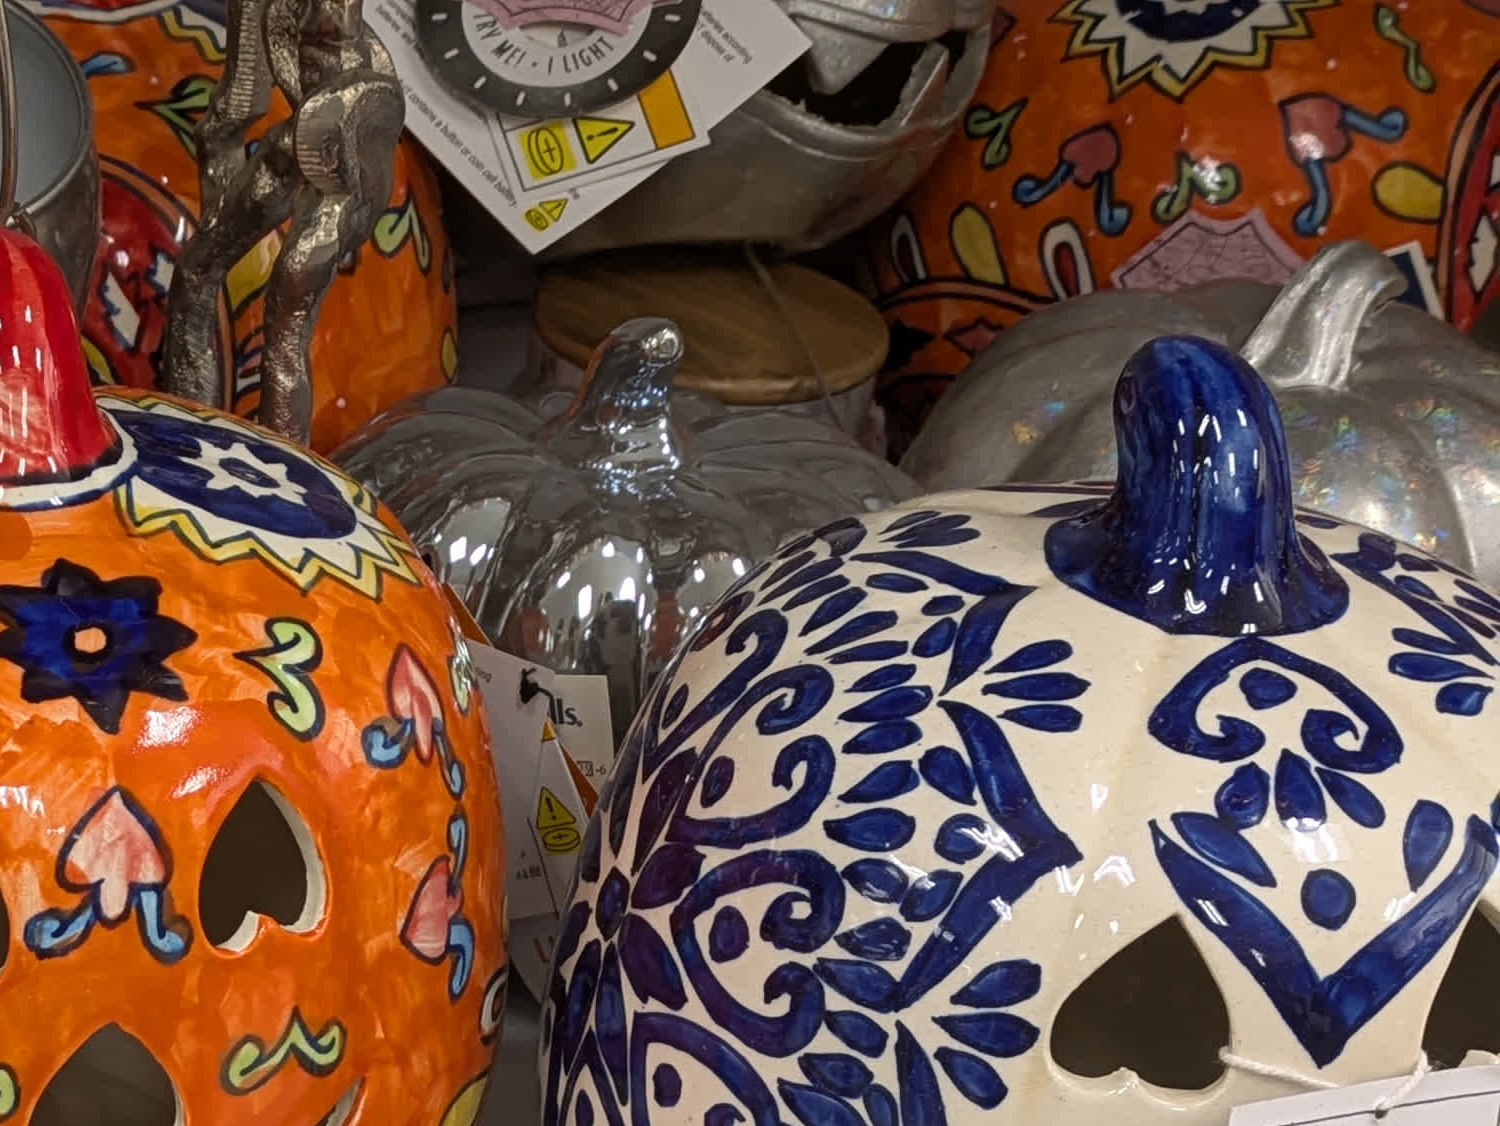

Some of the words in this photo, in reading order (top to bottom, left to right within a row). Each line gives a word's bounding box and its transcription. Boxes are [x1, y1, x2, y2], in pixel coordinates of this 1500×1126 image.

[473, 12, 502, 40] TRY
[491, 39, 526, 68] ME!
[562, 36, 614, 73] LIGHT
